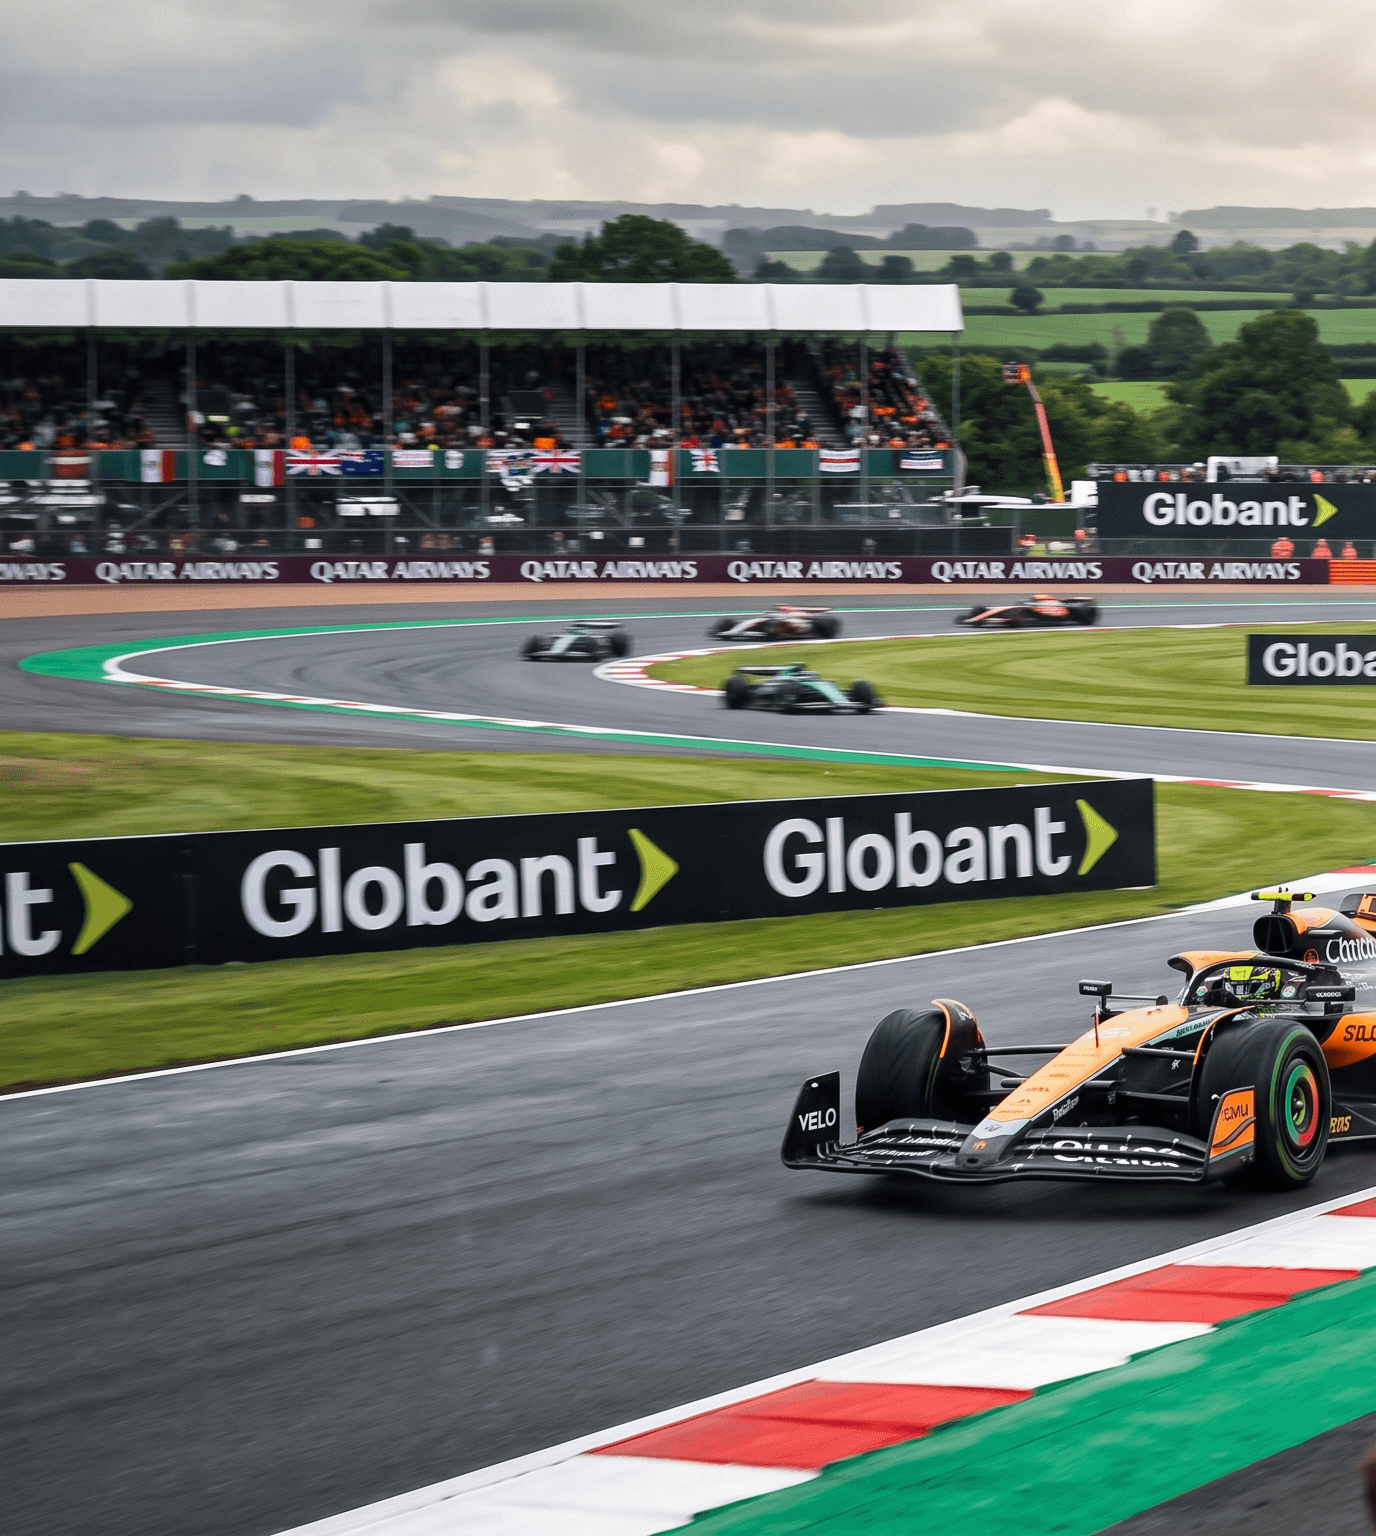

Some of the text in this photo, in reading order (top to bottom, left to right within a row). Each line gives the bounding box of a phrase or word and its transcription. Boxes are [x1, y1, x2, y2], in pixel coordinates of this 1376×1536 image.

[1142, 492, 1309, 526] Globant
[95, 562, 279, 583] QATAR AIRWAYS
[310, 561, 491, 582] QATAR AIRWAYS
[520, 561, 699, 582] QATAR AIRWAYS
[727, 561, 902, 582] QATAR AIRWAYS
[931, 561, 1103, 582] QATAR AIRWAYS
[1132, 562, 1301, 583] QATAR AIRWAYS
[763, 806, 1072, 898] Globant
[241, 836, 623, 938] Globant
[798, 1107, 837, 1132] VELO
